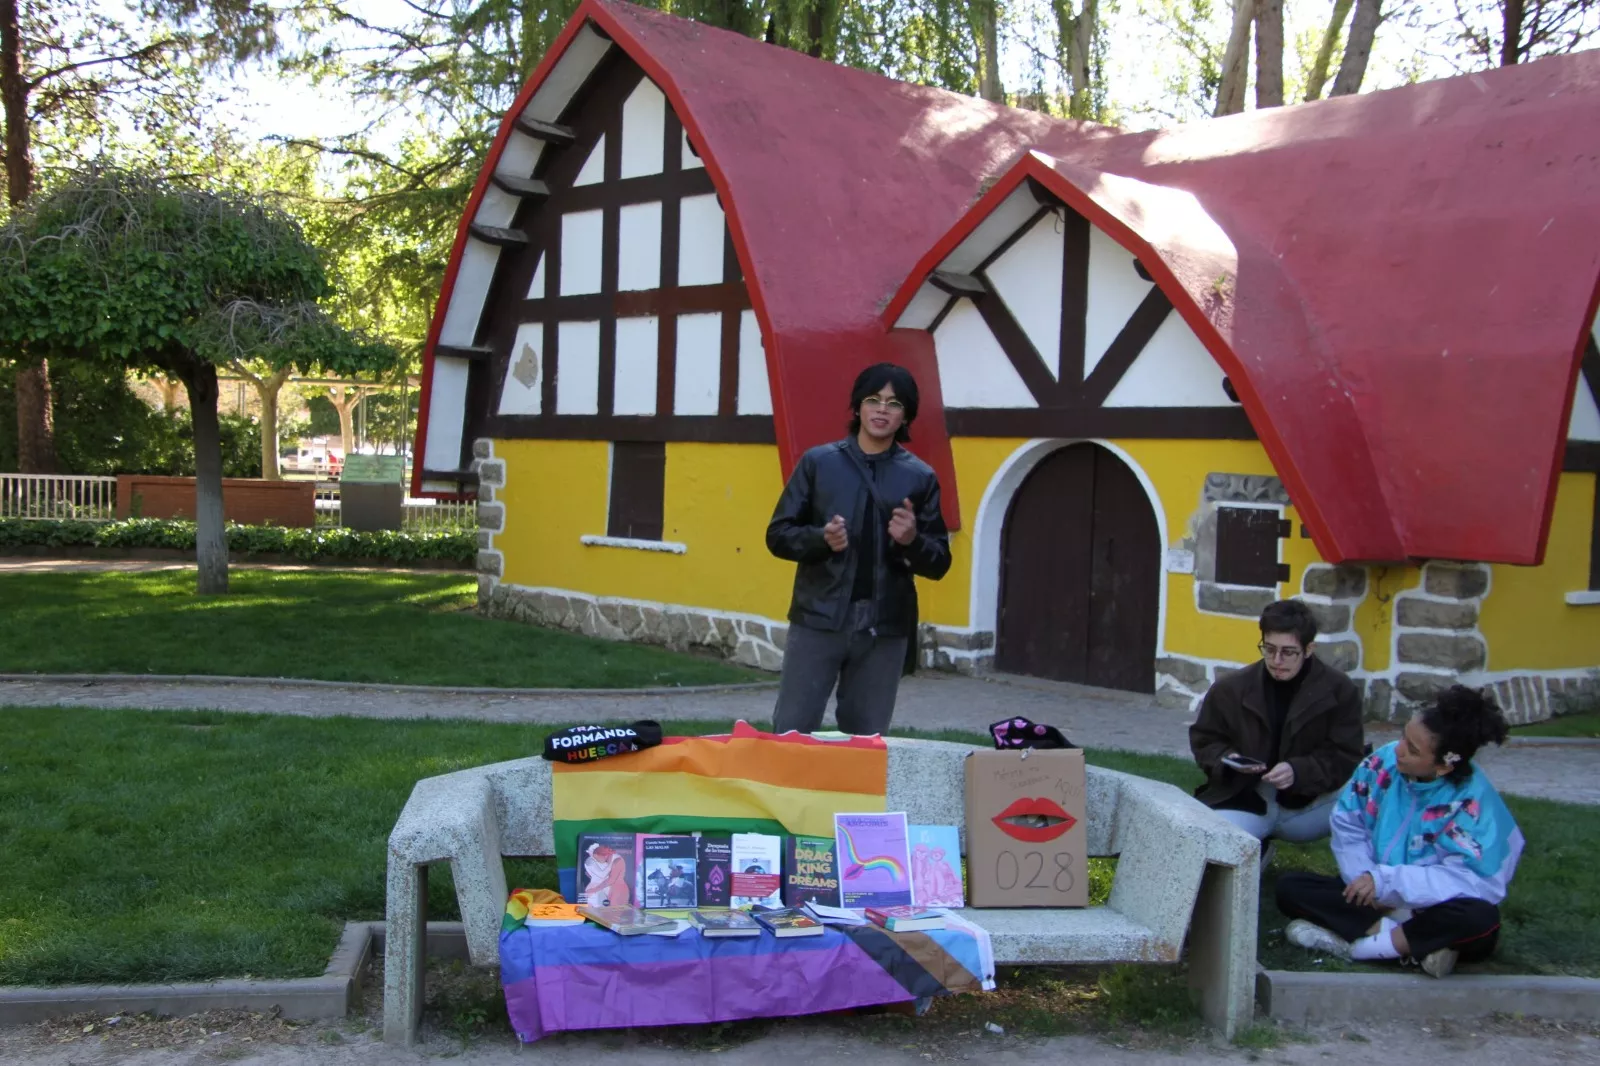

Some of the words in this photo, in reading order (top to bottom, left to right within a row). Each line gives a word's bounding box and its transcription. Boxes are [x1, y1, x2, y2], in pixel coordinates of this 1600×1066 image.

[552, 729, 637, 749] FORMANDO
[567, 742, 629, 760] HUESCA
[794, 848, 833, 862] DRAG
[796, 863, 832, 874] KING
[995, 850, 1075, 893] 028
[788, 874, 838, 889] DREAMS
